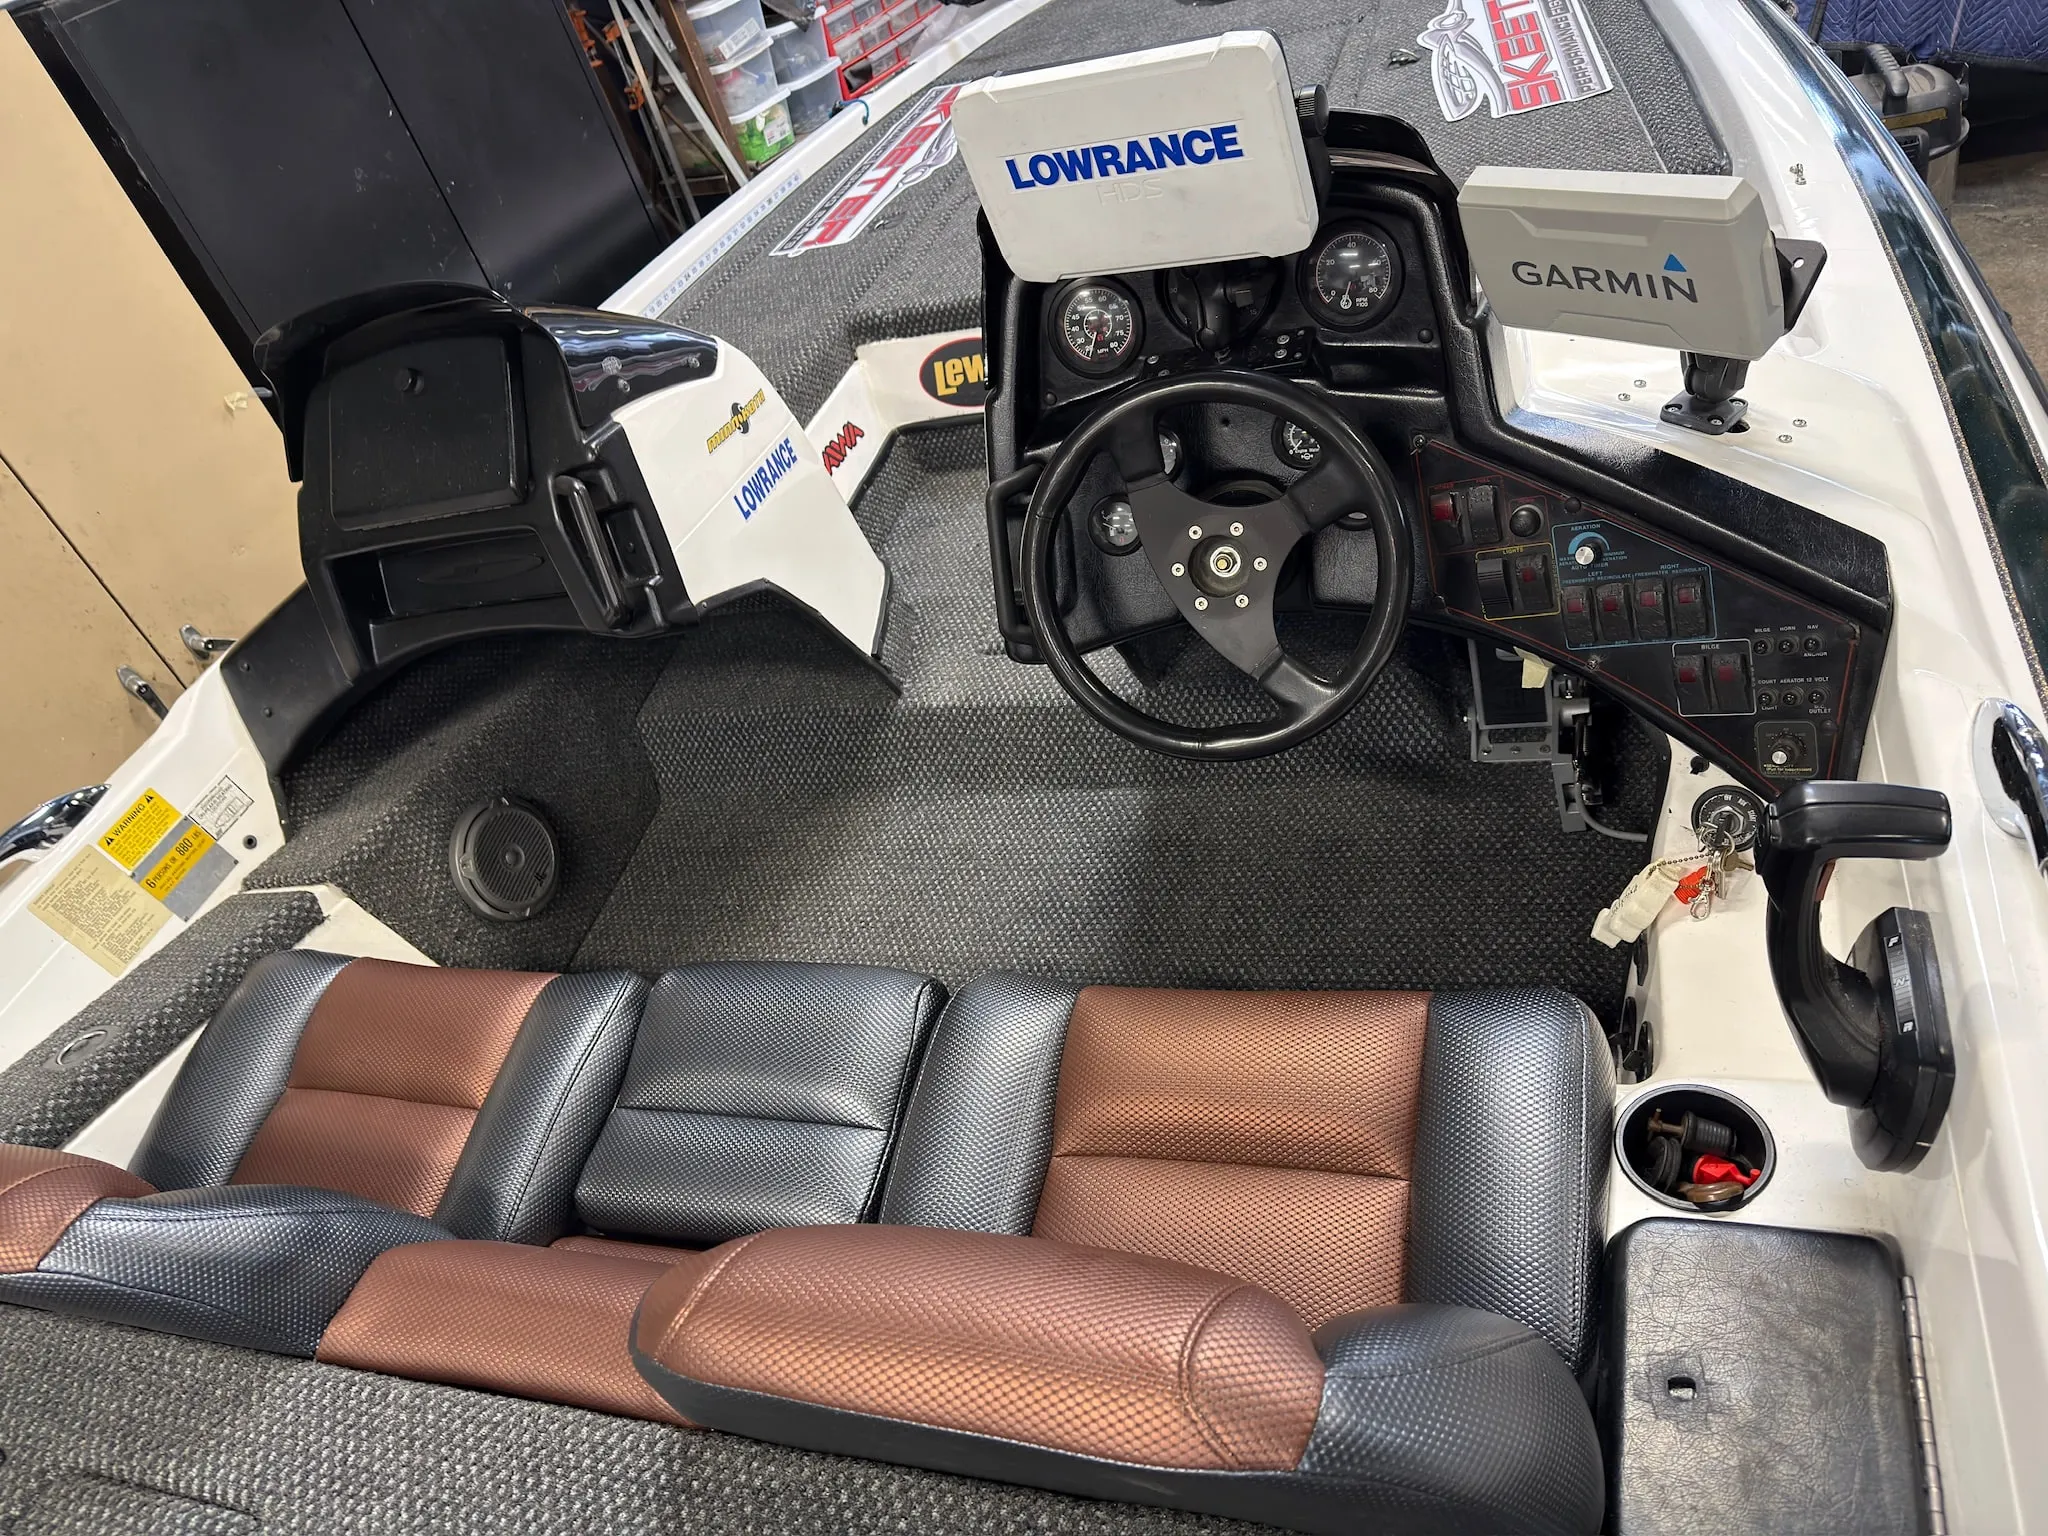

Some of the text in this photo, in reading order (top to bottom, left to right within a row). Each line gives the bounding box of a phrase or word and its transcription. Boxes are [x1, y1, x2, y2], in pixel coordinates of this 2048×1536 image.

[1555, 15, 1597, 95] PERFORMANCE
[1005, 124, 1244, 189] LOWRANCE
[1511, 260, 1698, 304] GARMIN
[733, 437, 798, 521] LOWRANCE
[1570, 523, 1601, 532] AERATION
[1660, 563, 1680, 571] RIGHT
[112, 803, 146, 837] WARNING
[145, 879, 156, 889] 6
[153, 863, 171, 884] PERSONS
[175, 837, 194, 857] 880
[1888, 936, 1899, 947] F
[1895, 976, 1906, 987] N
[1902, 1021, 1914, 1032] R
